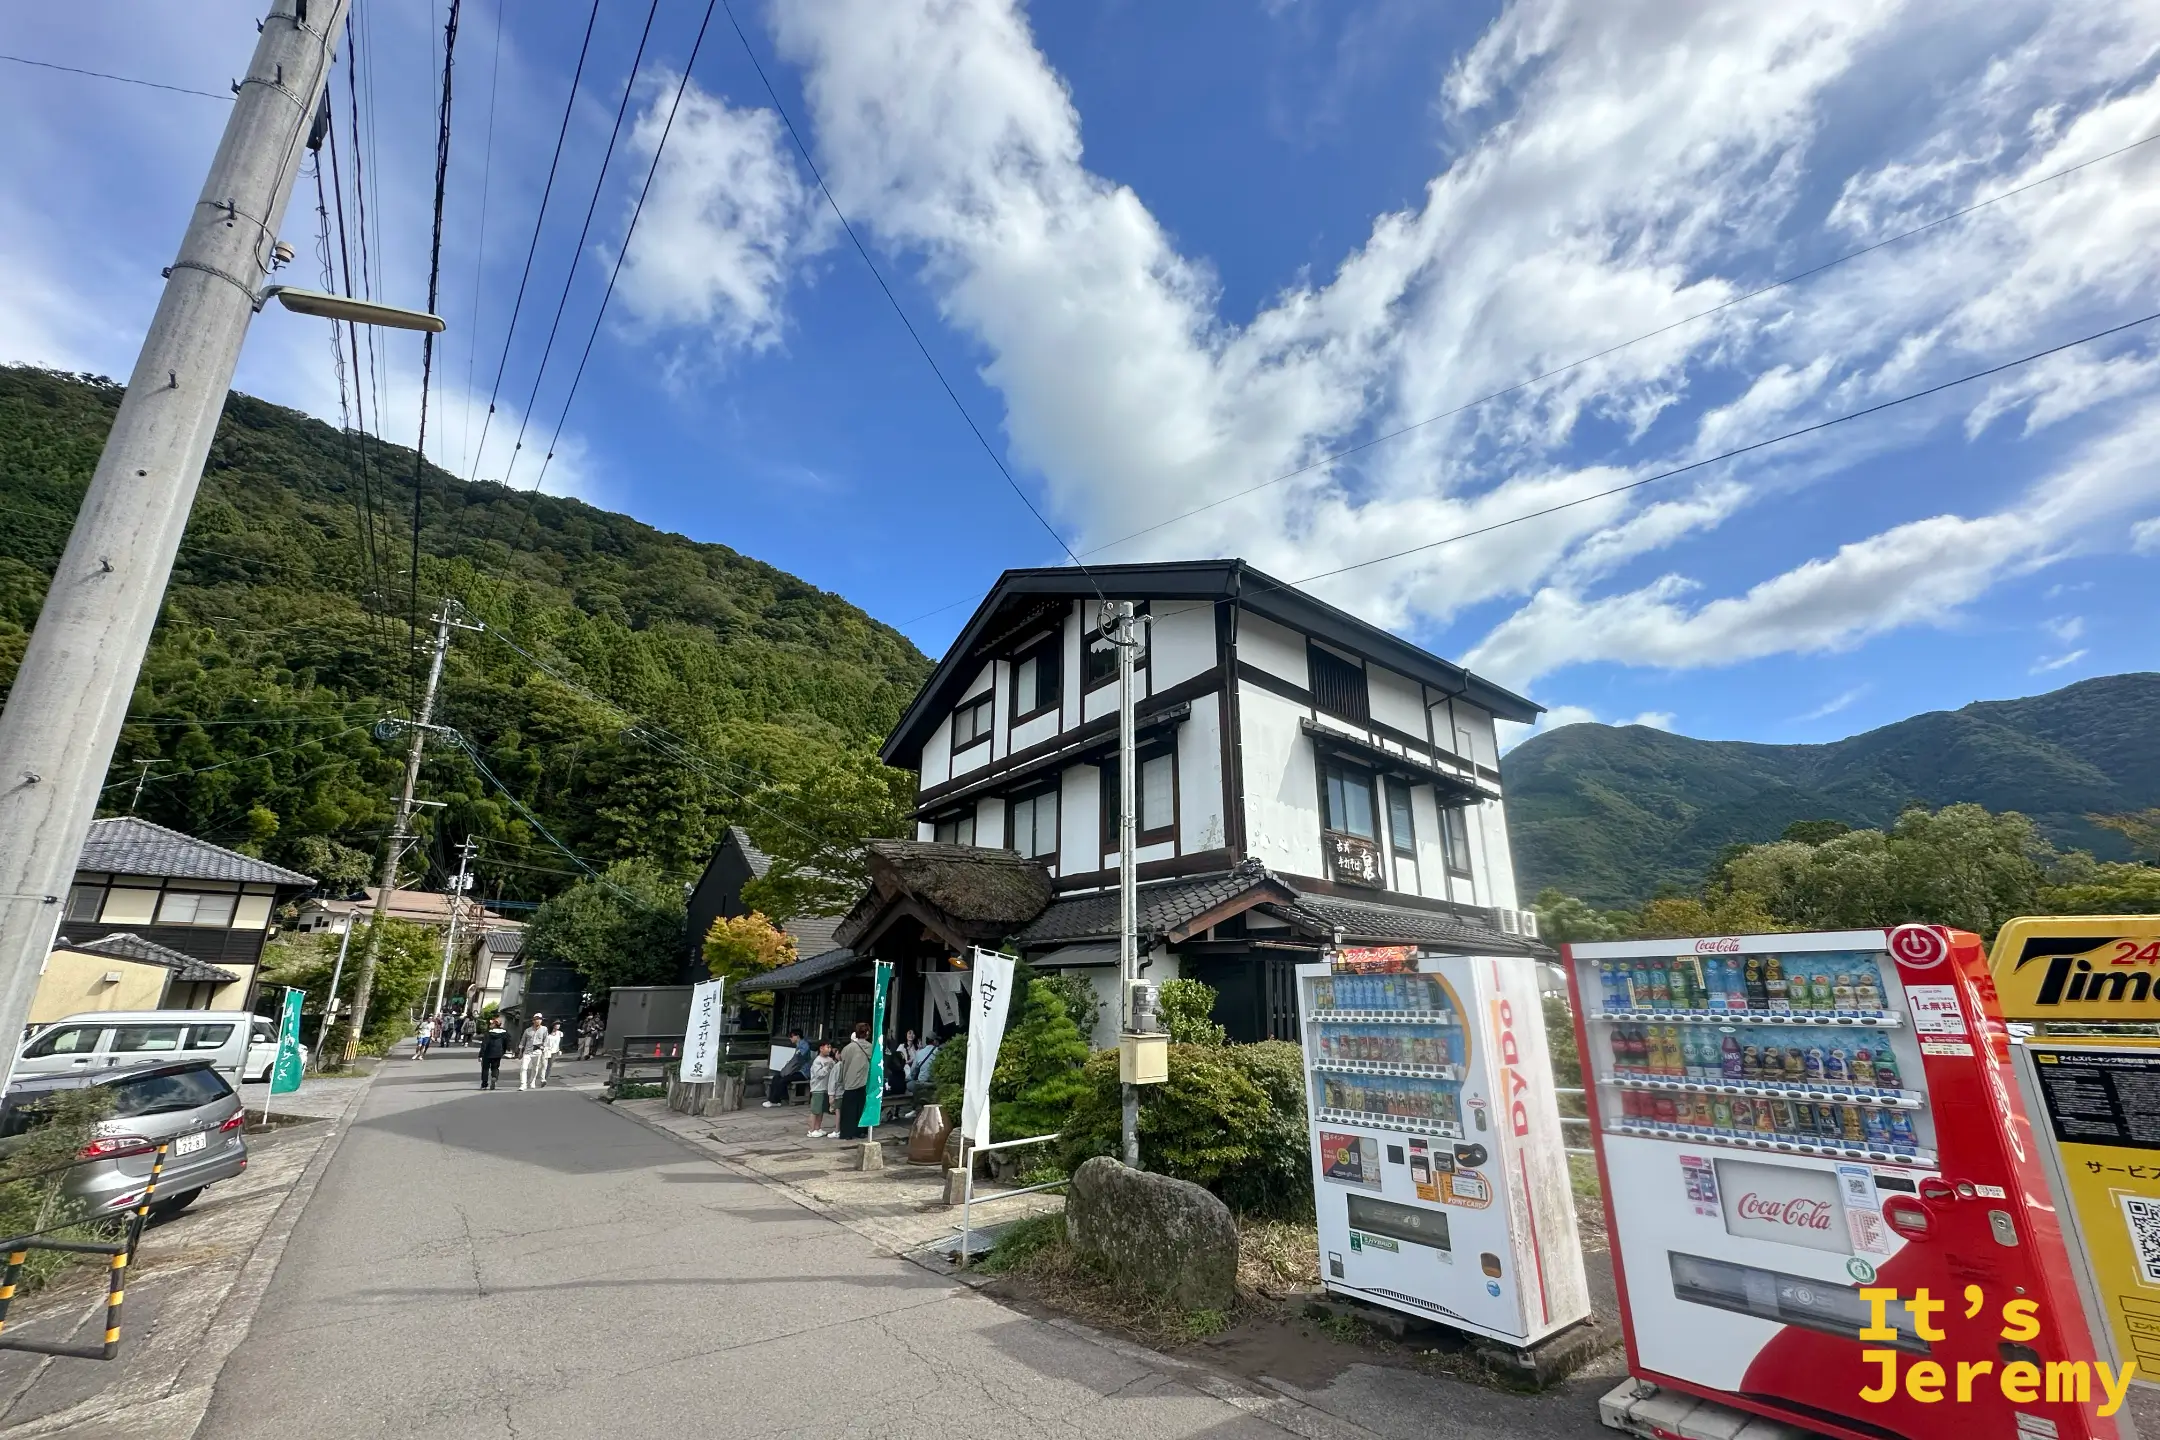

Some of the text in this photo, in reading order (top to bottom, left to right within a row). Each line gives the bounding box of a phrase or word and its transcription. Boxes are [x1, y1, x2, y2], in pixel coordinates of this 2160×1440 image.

[1695, 937, 1740, 953] Coca-Cola
[1345, 948, 1399, 961] モンスターハンター
[1738, 1192, 1832, 1231] Coca-Cola
